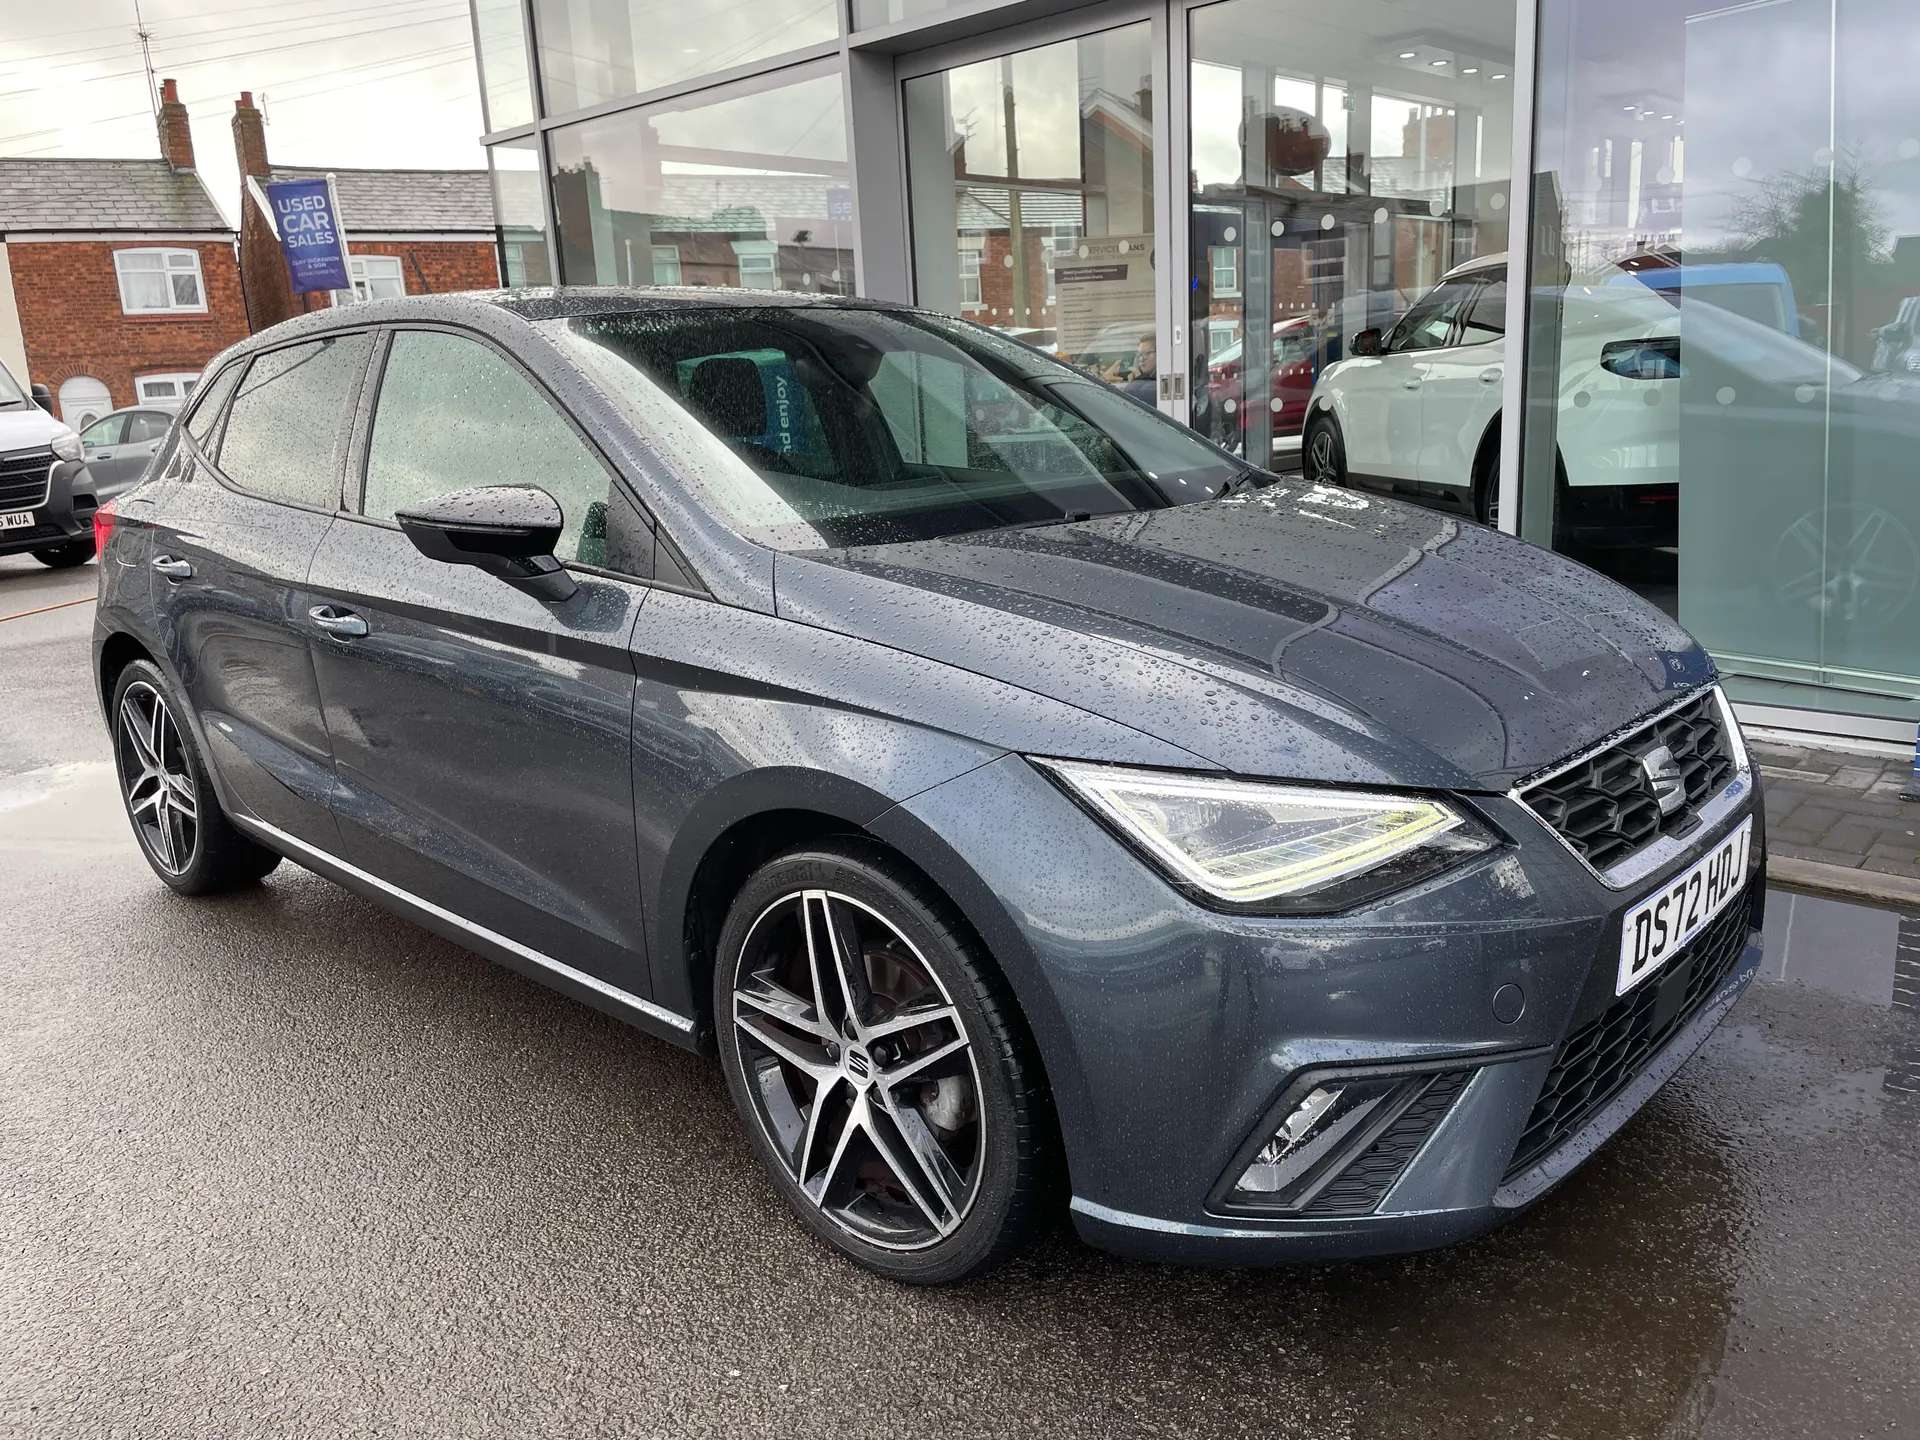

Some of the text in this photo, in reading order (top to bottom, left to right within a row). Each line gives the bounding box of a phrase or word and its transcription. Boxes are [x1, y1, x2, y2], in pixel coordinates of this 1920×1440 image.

[278, 195, 326, 213] USED
[283, 211, 331, 233] CAR
[287, 231, 335, 248] SALES
[775, 375, 792, 453] nd enjoy
[6, 514, 30, 526] WUA
[1631, 830, 1745, 975] DS72 HDJ
